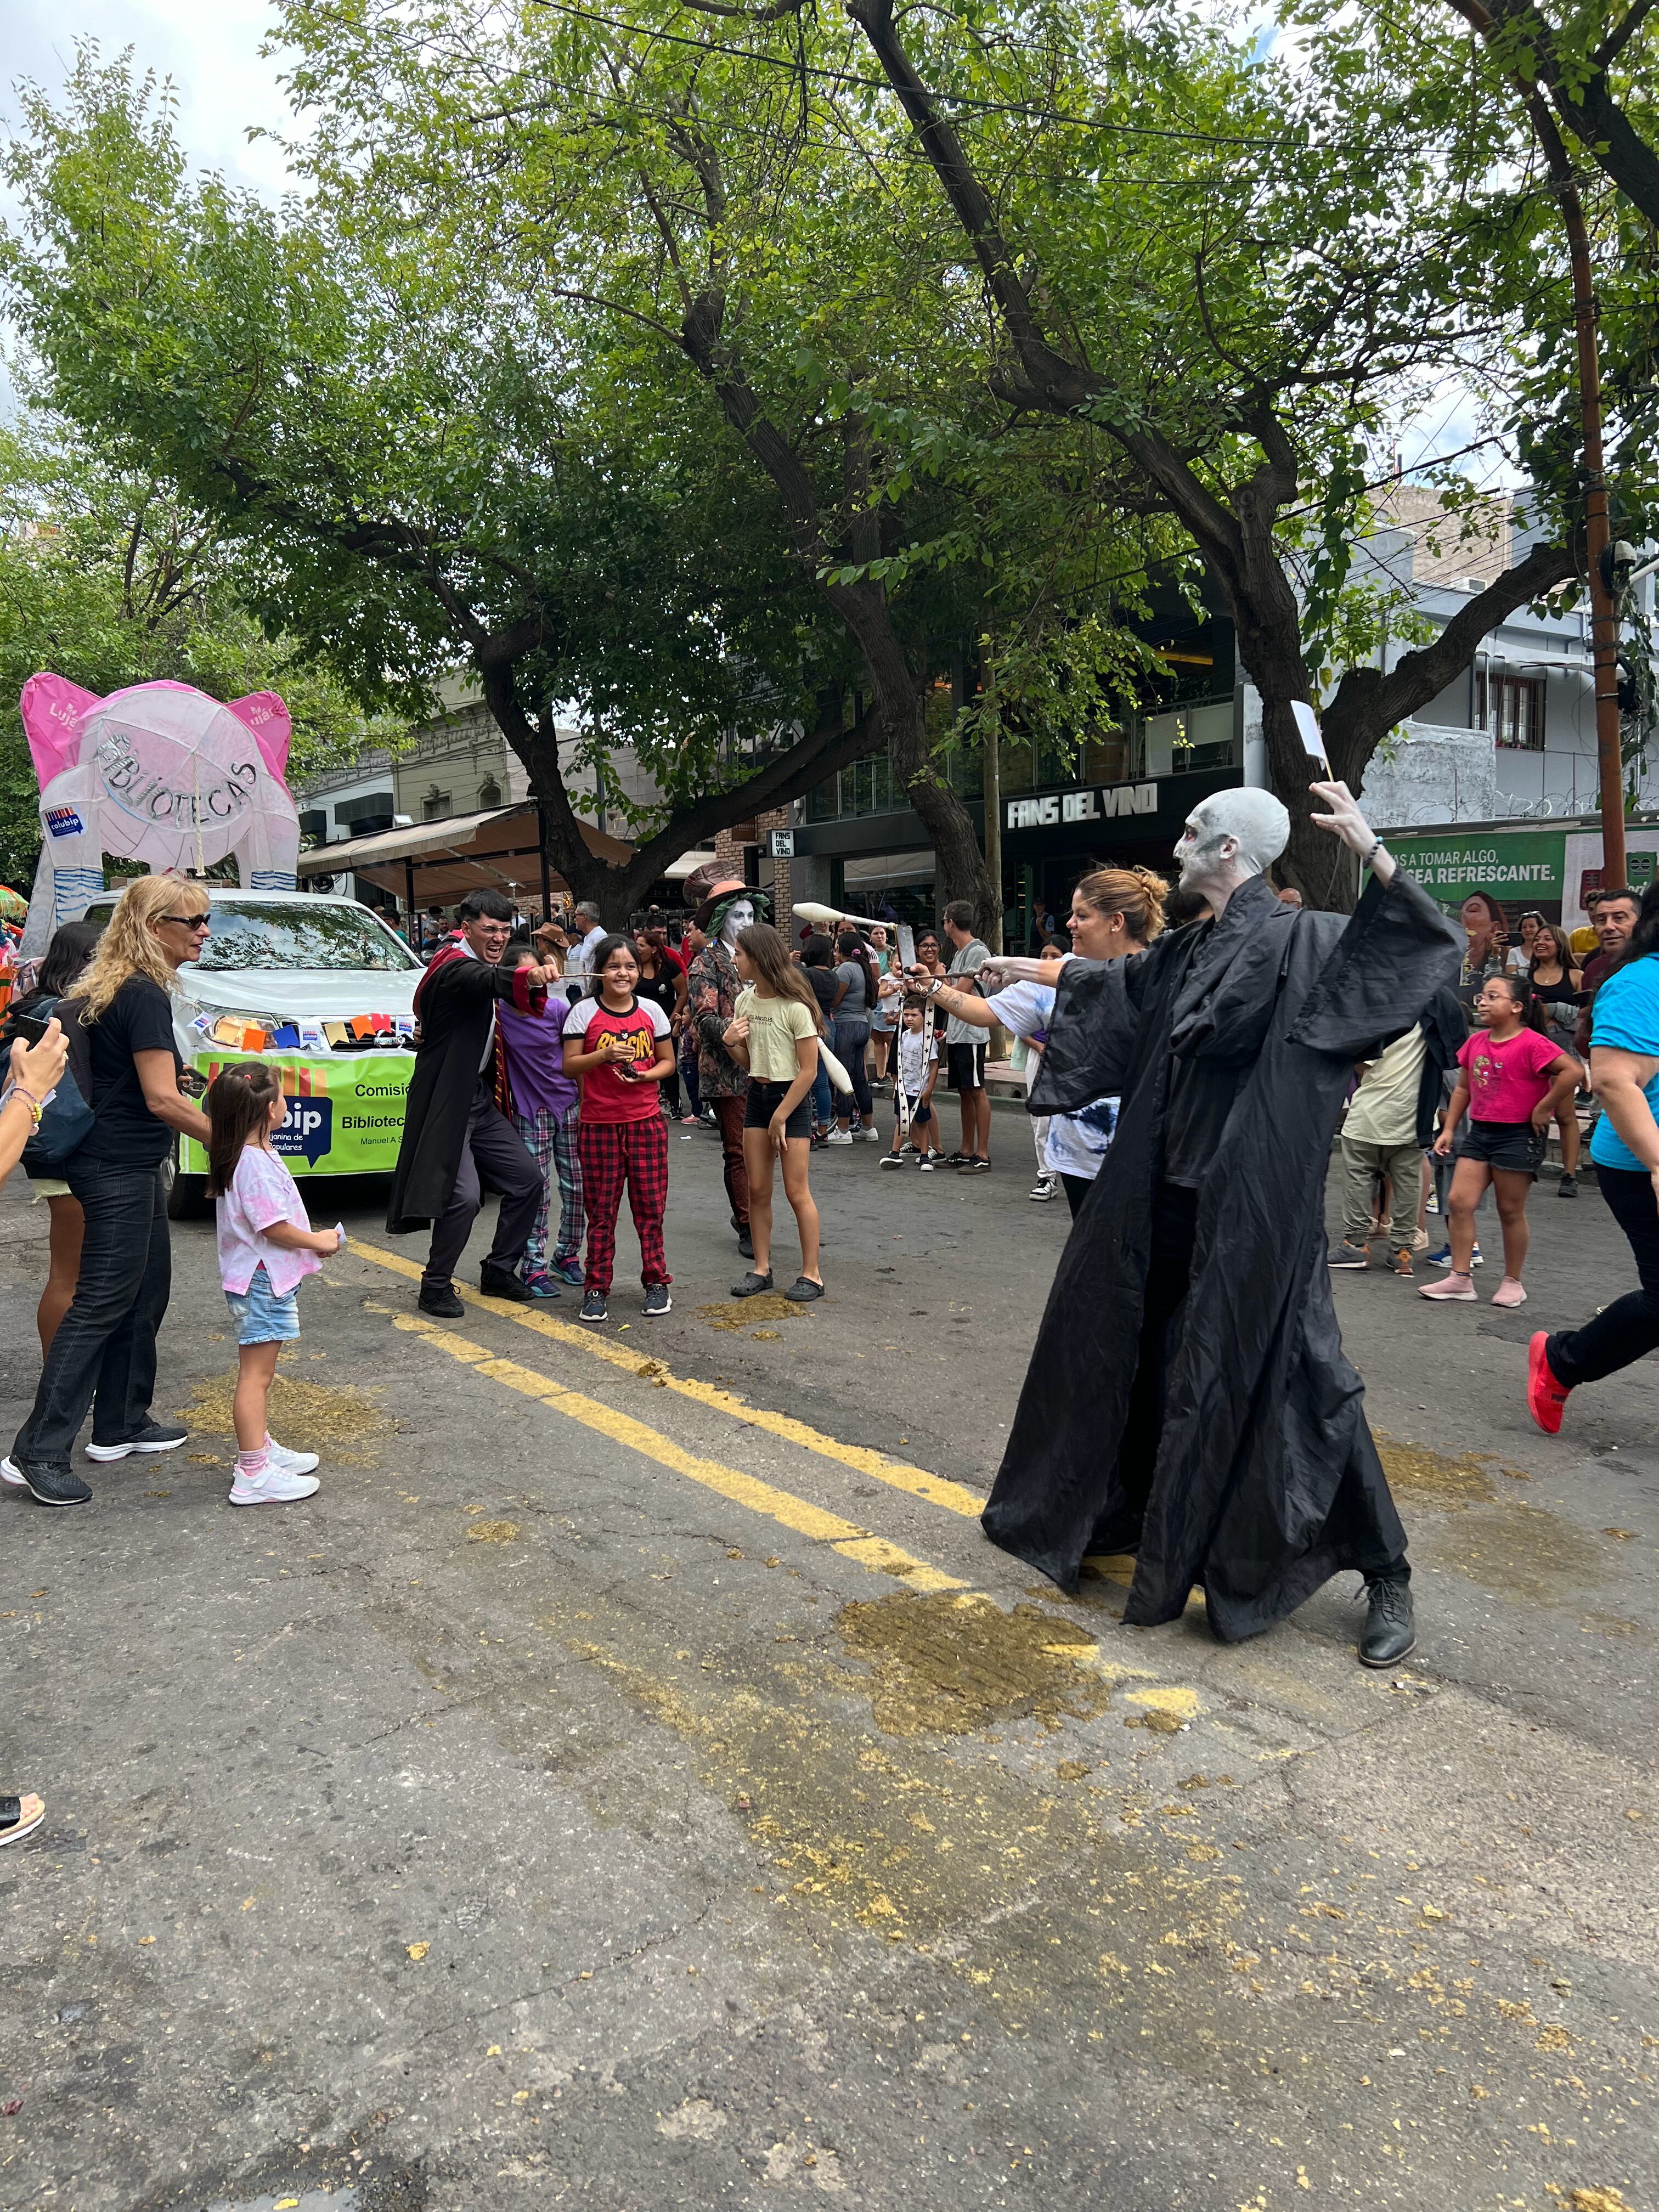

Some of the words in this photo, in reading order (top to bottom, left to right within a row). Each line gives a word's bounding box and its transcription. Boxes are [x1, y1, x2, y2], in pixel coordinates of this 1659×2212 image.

[1007, 796, 1059, 829] FANS
[1062, 791, 1101, 822] DEL
[1102, 783, 1158, 817] VINO
[51, 817, 79, 830] colubip
[1391, 854, 1407, 866] AS
[1408, 853, 1417, 866] A
[1419, 851, 1460, 865] TOMAR
[1462, 849, 1499, 864] ALGO,
[1437, 864, 1555, 883] REFRESCANTE.
[342, 1116, 405, 1128] Bibliotec
[269, 1133, 292, 1142] janina
[360, 1137, 388, 1145] Manuel
